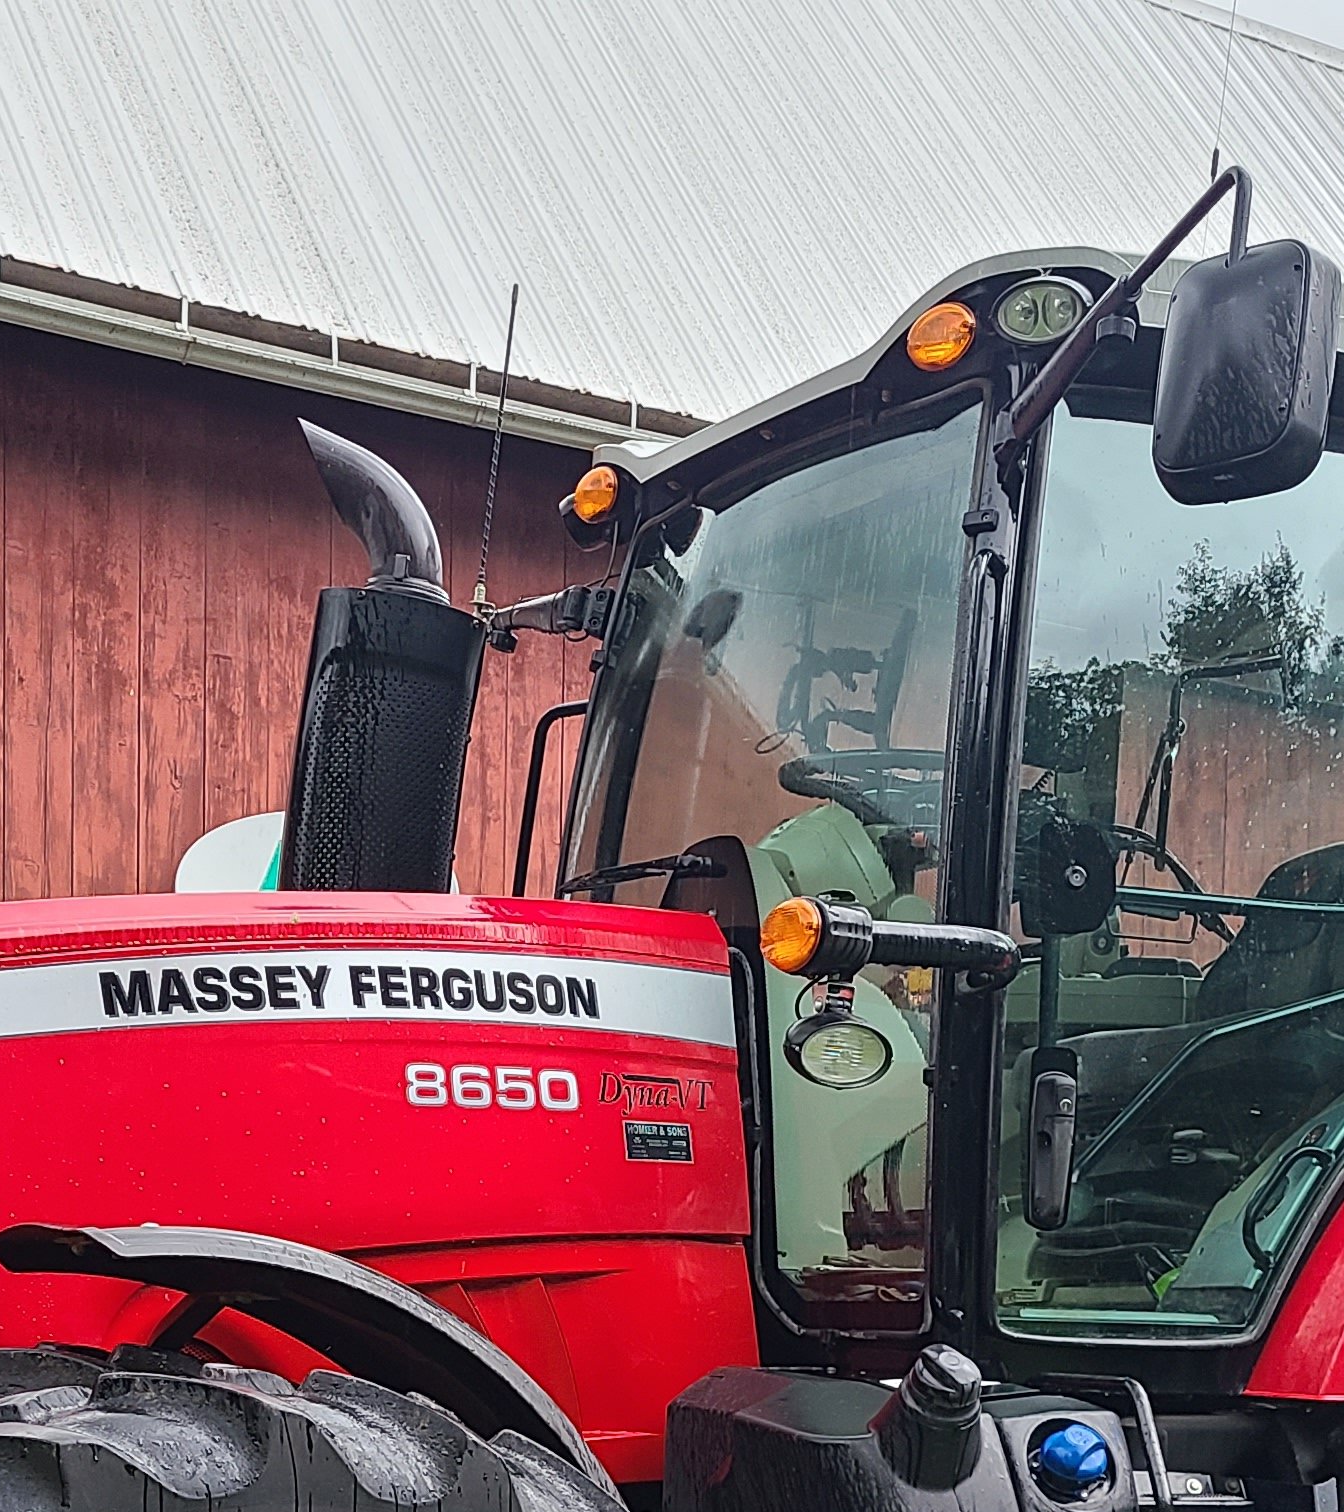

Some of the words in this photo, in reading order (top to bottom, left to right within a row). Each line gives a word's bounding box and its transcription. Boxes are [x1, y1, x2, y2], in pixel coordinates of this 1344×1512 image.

[98, 965, 331, 1018] MASSEY
[349, 964, 600, 1019] FERGUSON
[405, 1062, 579, 1112] 8650
[667, 1126, 687, 1137] SONS
